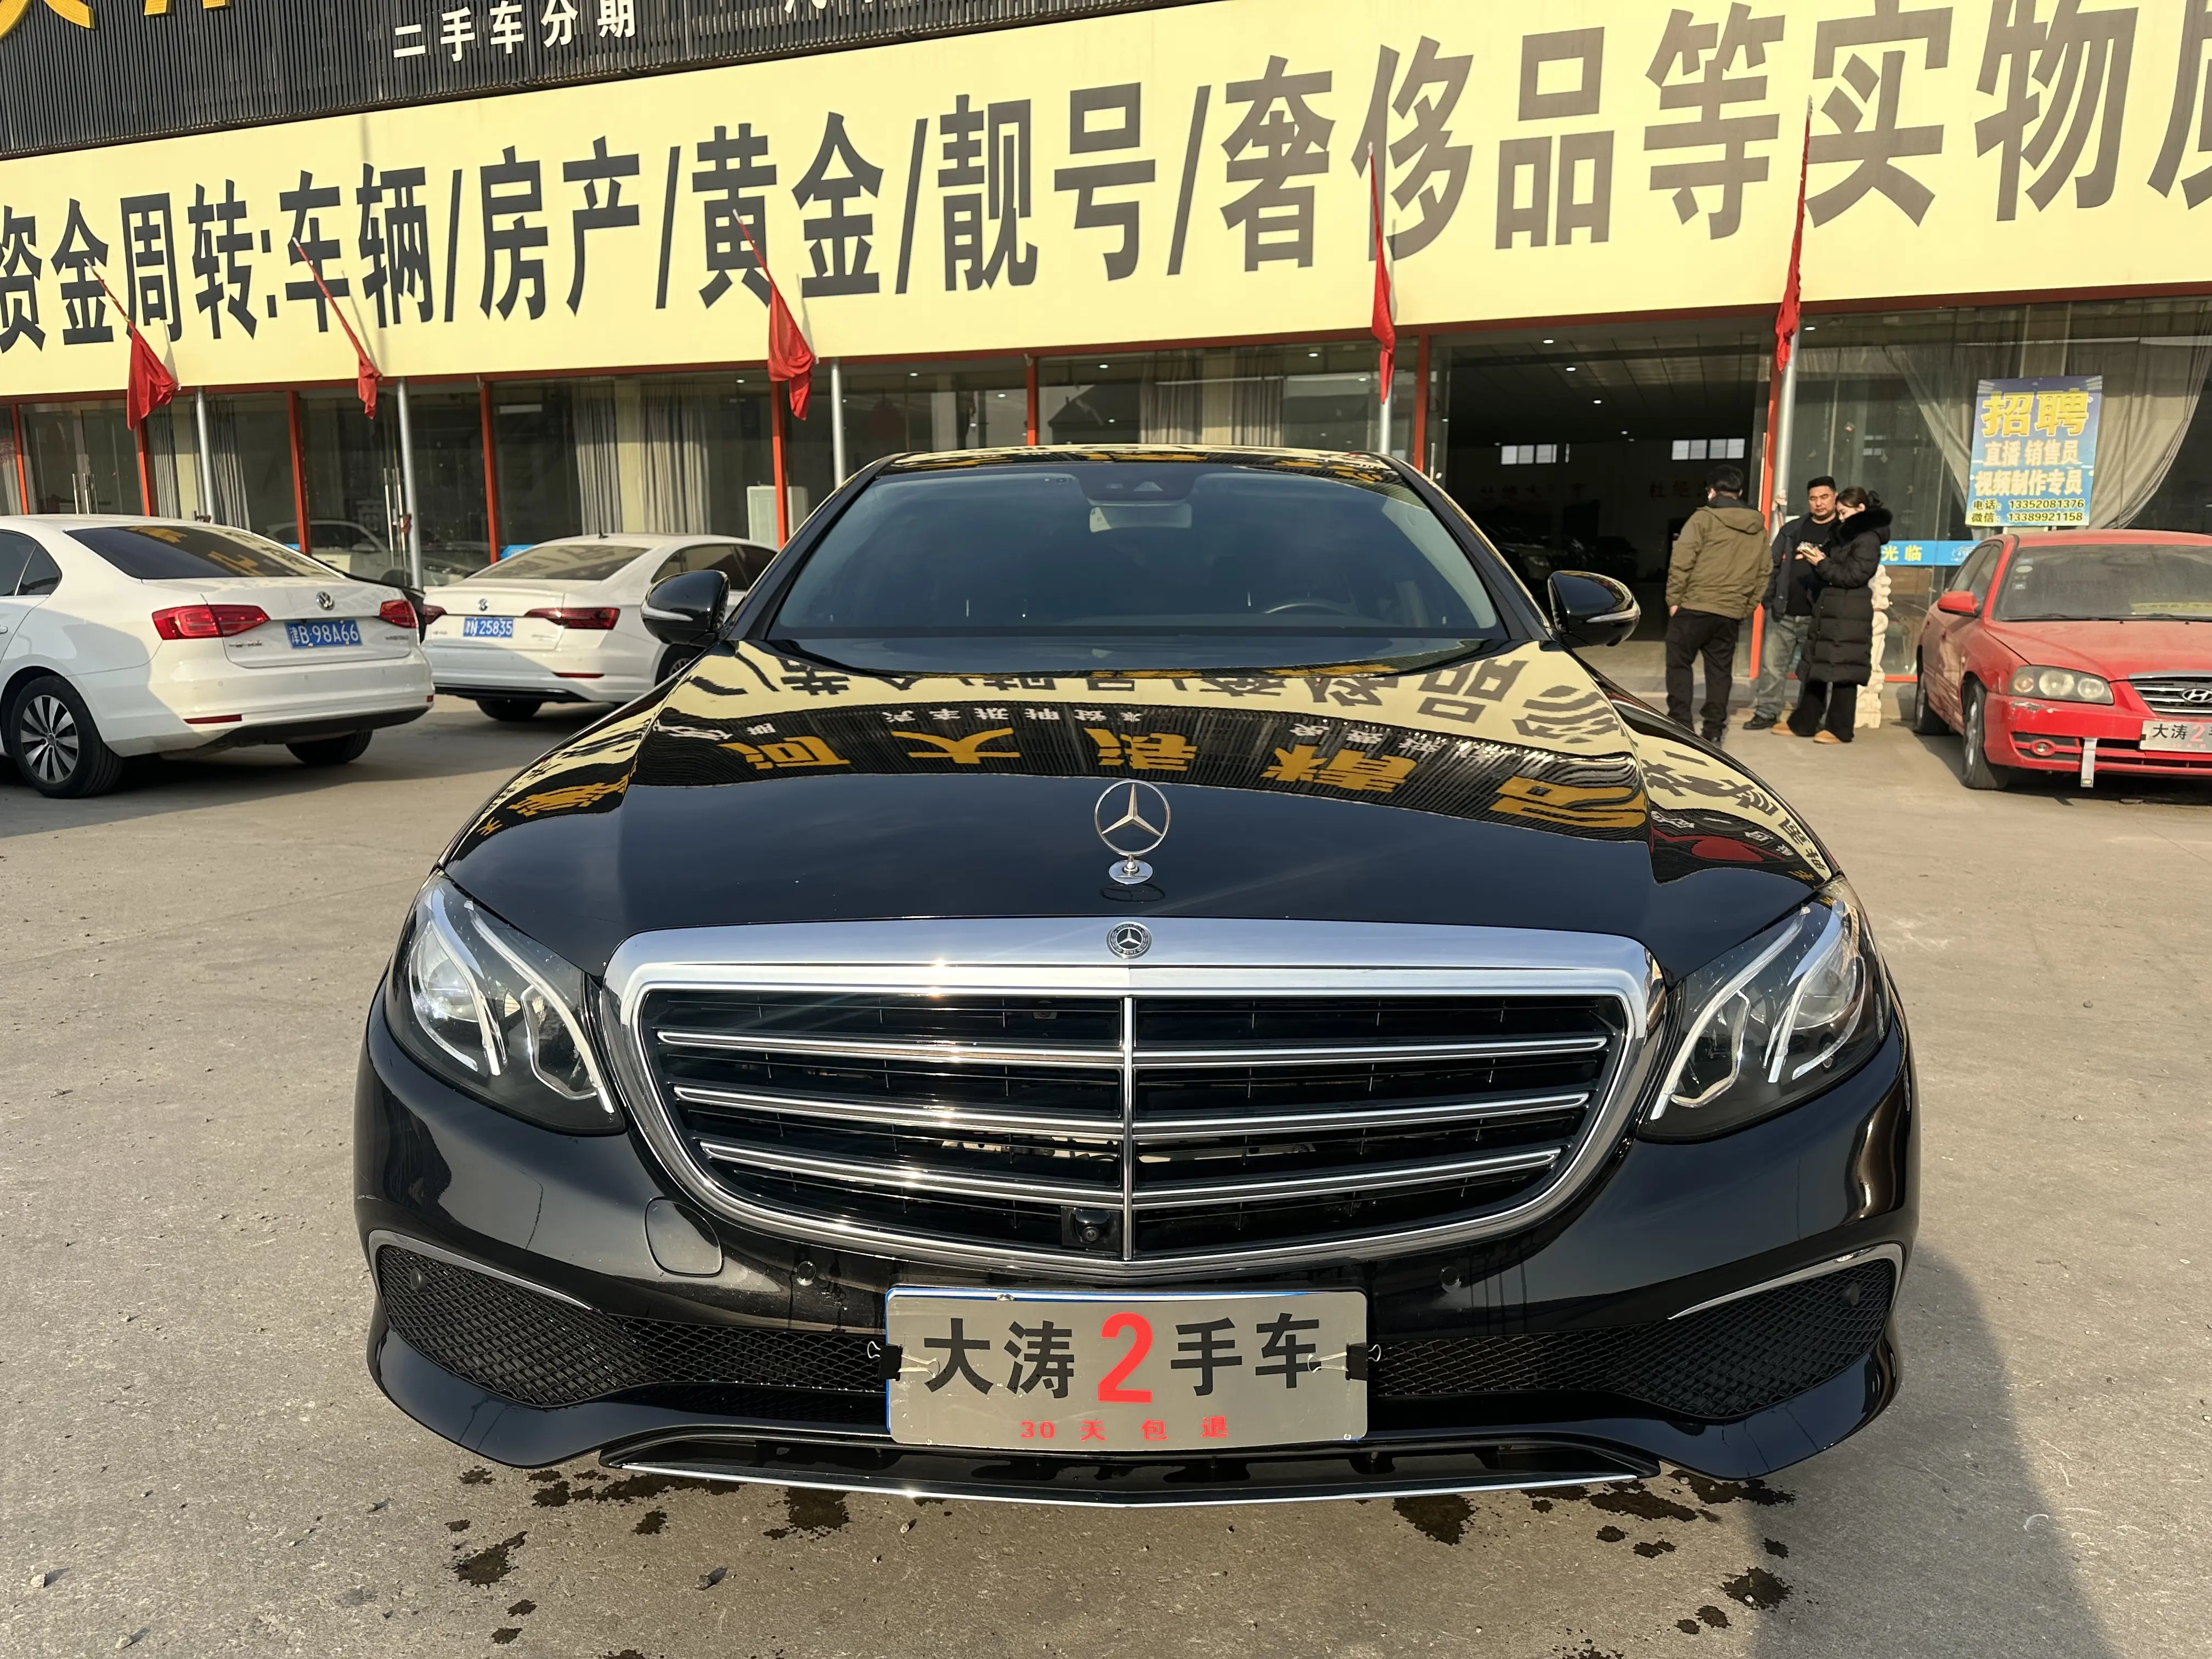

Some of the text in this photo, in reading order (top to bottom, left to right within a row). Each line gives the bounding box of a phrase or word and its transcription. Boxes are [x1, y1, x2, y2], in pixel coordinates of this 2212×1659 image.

[393, 0, 636, 62] 二手车分期
[1981, 387, 2089, 437] 招聘
[1983, 439, 2079, 466] 直播 销售员
[1974, 469, 2083, 496] 视频制作专员
[2008, 499, 2085, 510] 13352081376
[2008, 511, 2083, 522] 13389921158
[2153, 724, 2212, 742] 大涛2
[924, 1312, 1319, 1404] 大涛2手车
